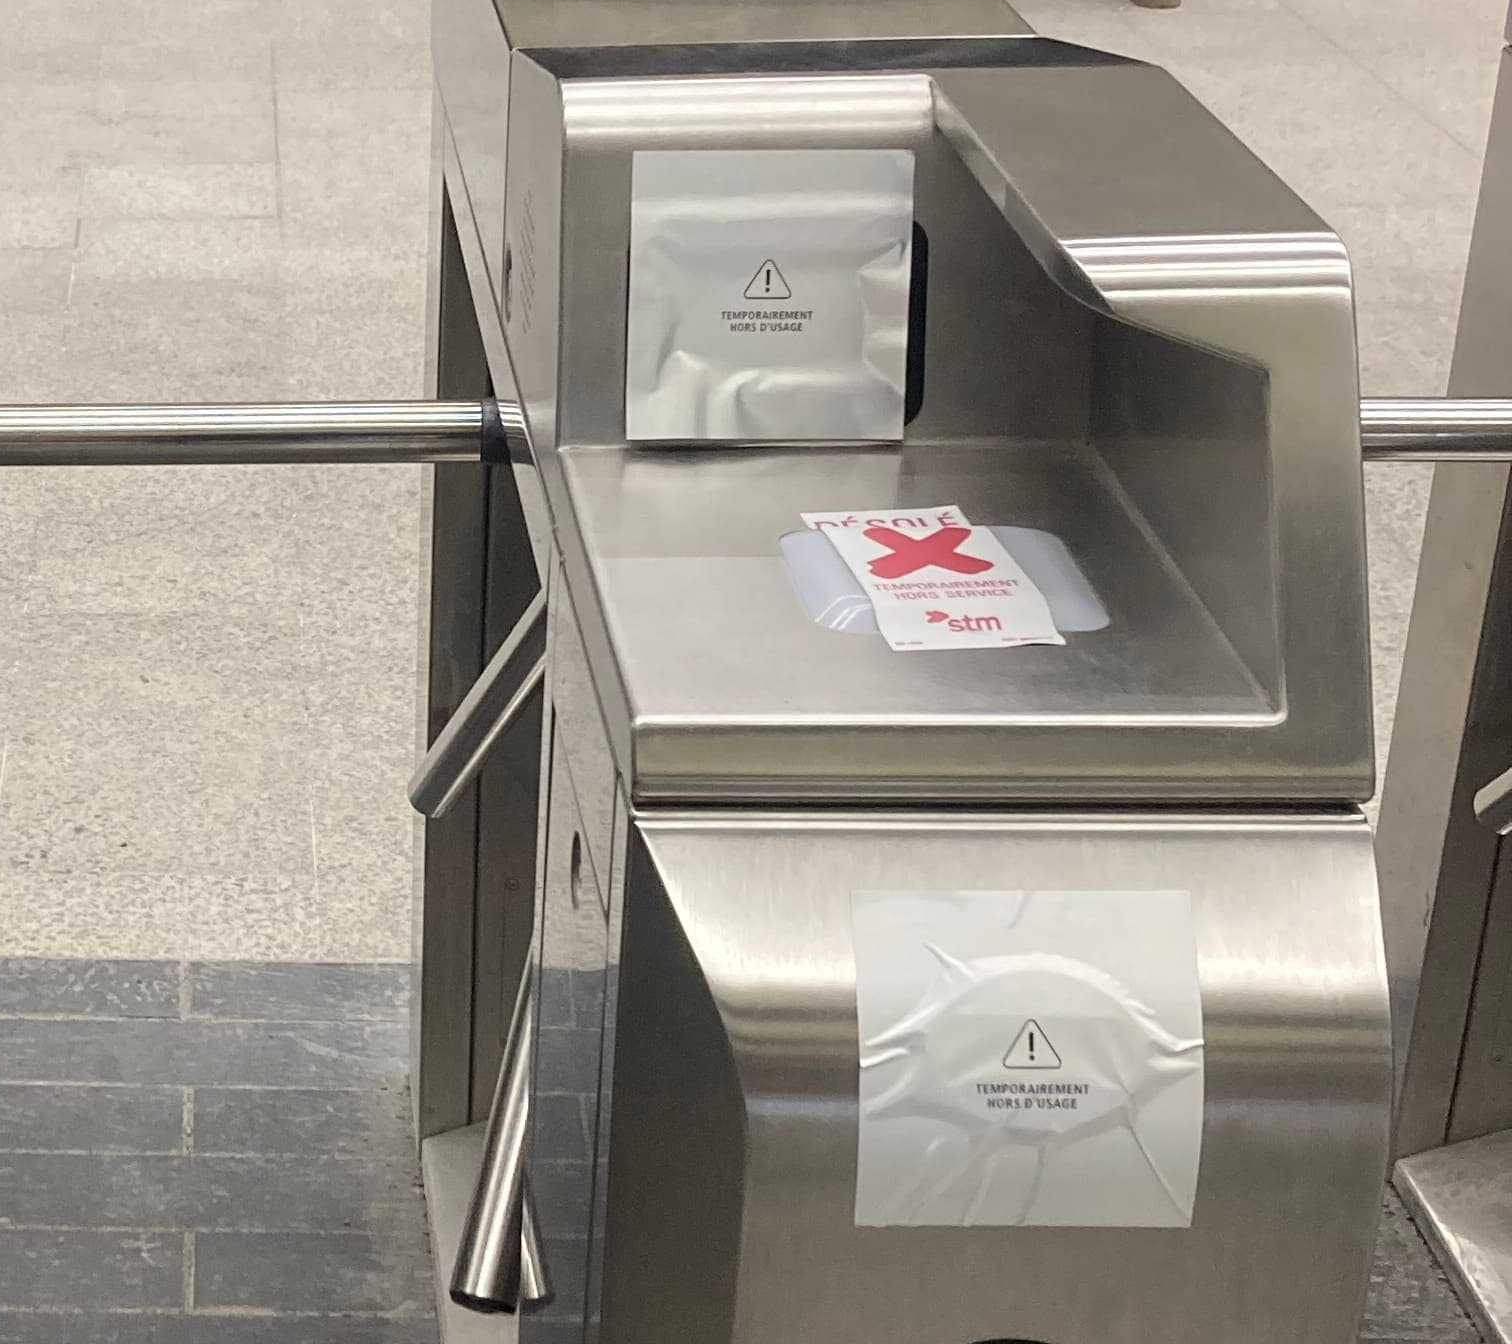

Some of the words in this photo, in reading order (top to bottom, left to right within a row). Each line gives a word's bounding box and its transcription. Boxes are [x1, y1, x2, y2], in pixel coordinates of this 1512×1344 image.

[720, 310, 814, 321] TEMPORAIREMENT
[729, 322, 757, 333] HORS
[759, 322, 803, 333] D'USAGE
[872, 578, 1019, 592] TEMPORAIREMENT
[894, 588, 940, 601] HORS
[946, 587, 1014, 599] SERVICE
[947, 614, 1003, 633] stm
[975, 1083, 1090, 1095] TEMPORAIREMENT
[986, 1097, 1021, 1110] HORS
[1023, 1097, 1079, 1110] D'USAGE
